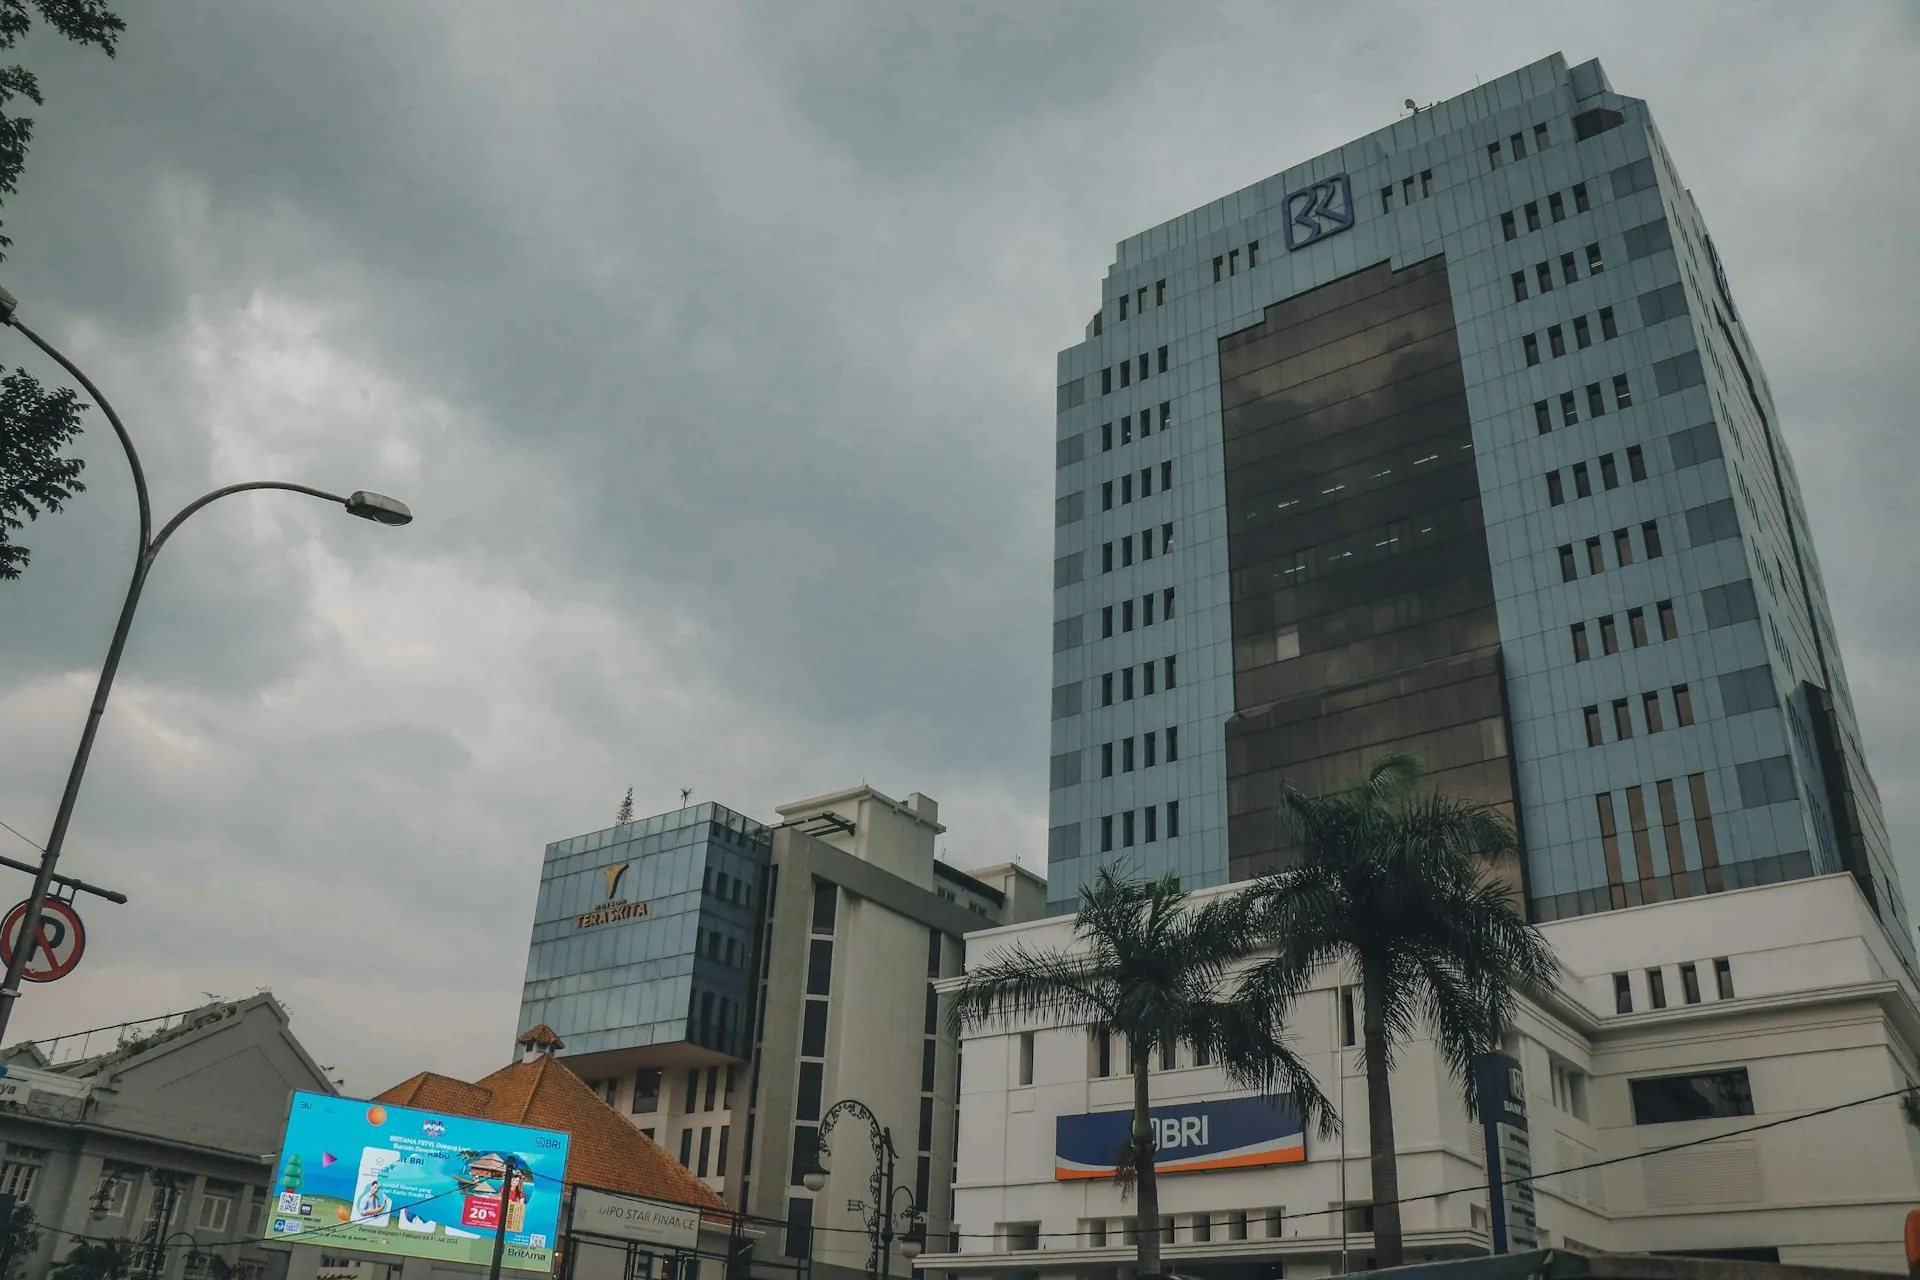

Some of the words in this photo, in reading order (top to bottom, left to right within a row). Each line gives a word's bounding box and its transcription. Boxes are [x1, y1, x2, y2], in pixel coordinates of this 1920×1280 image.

[1162, 1115, 1209, 1148] BRI
[390, 1135, 417, 1145] BRITAMA
[545, 1139, 561, 1149] BRI
[410, 1157, 424, 1166] BRI
[626, 1208, 650, 1223] STAR
[653, 1213, 696, 1230] FINANCE
[508, 1248, 546, 1260] BritAma
